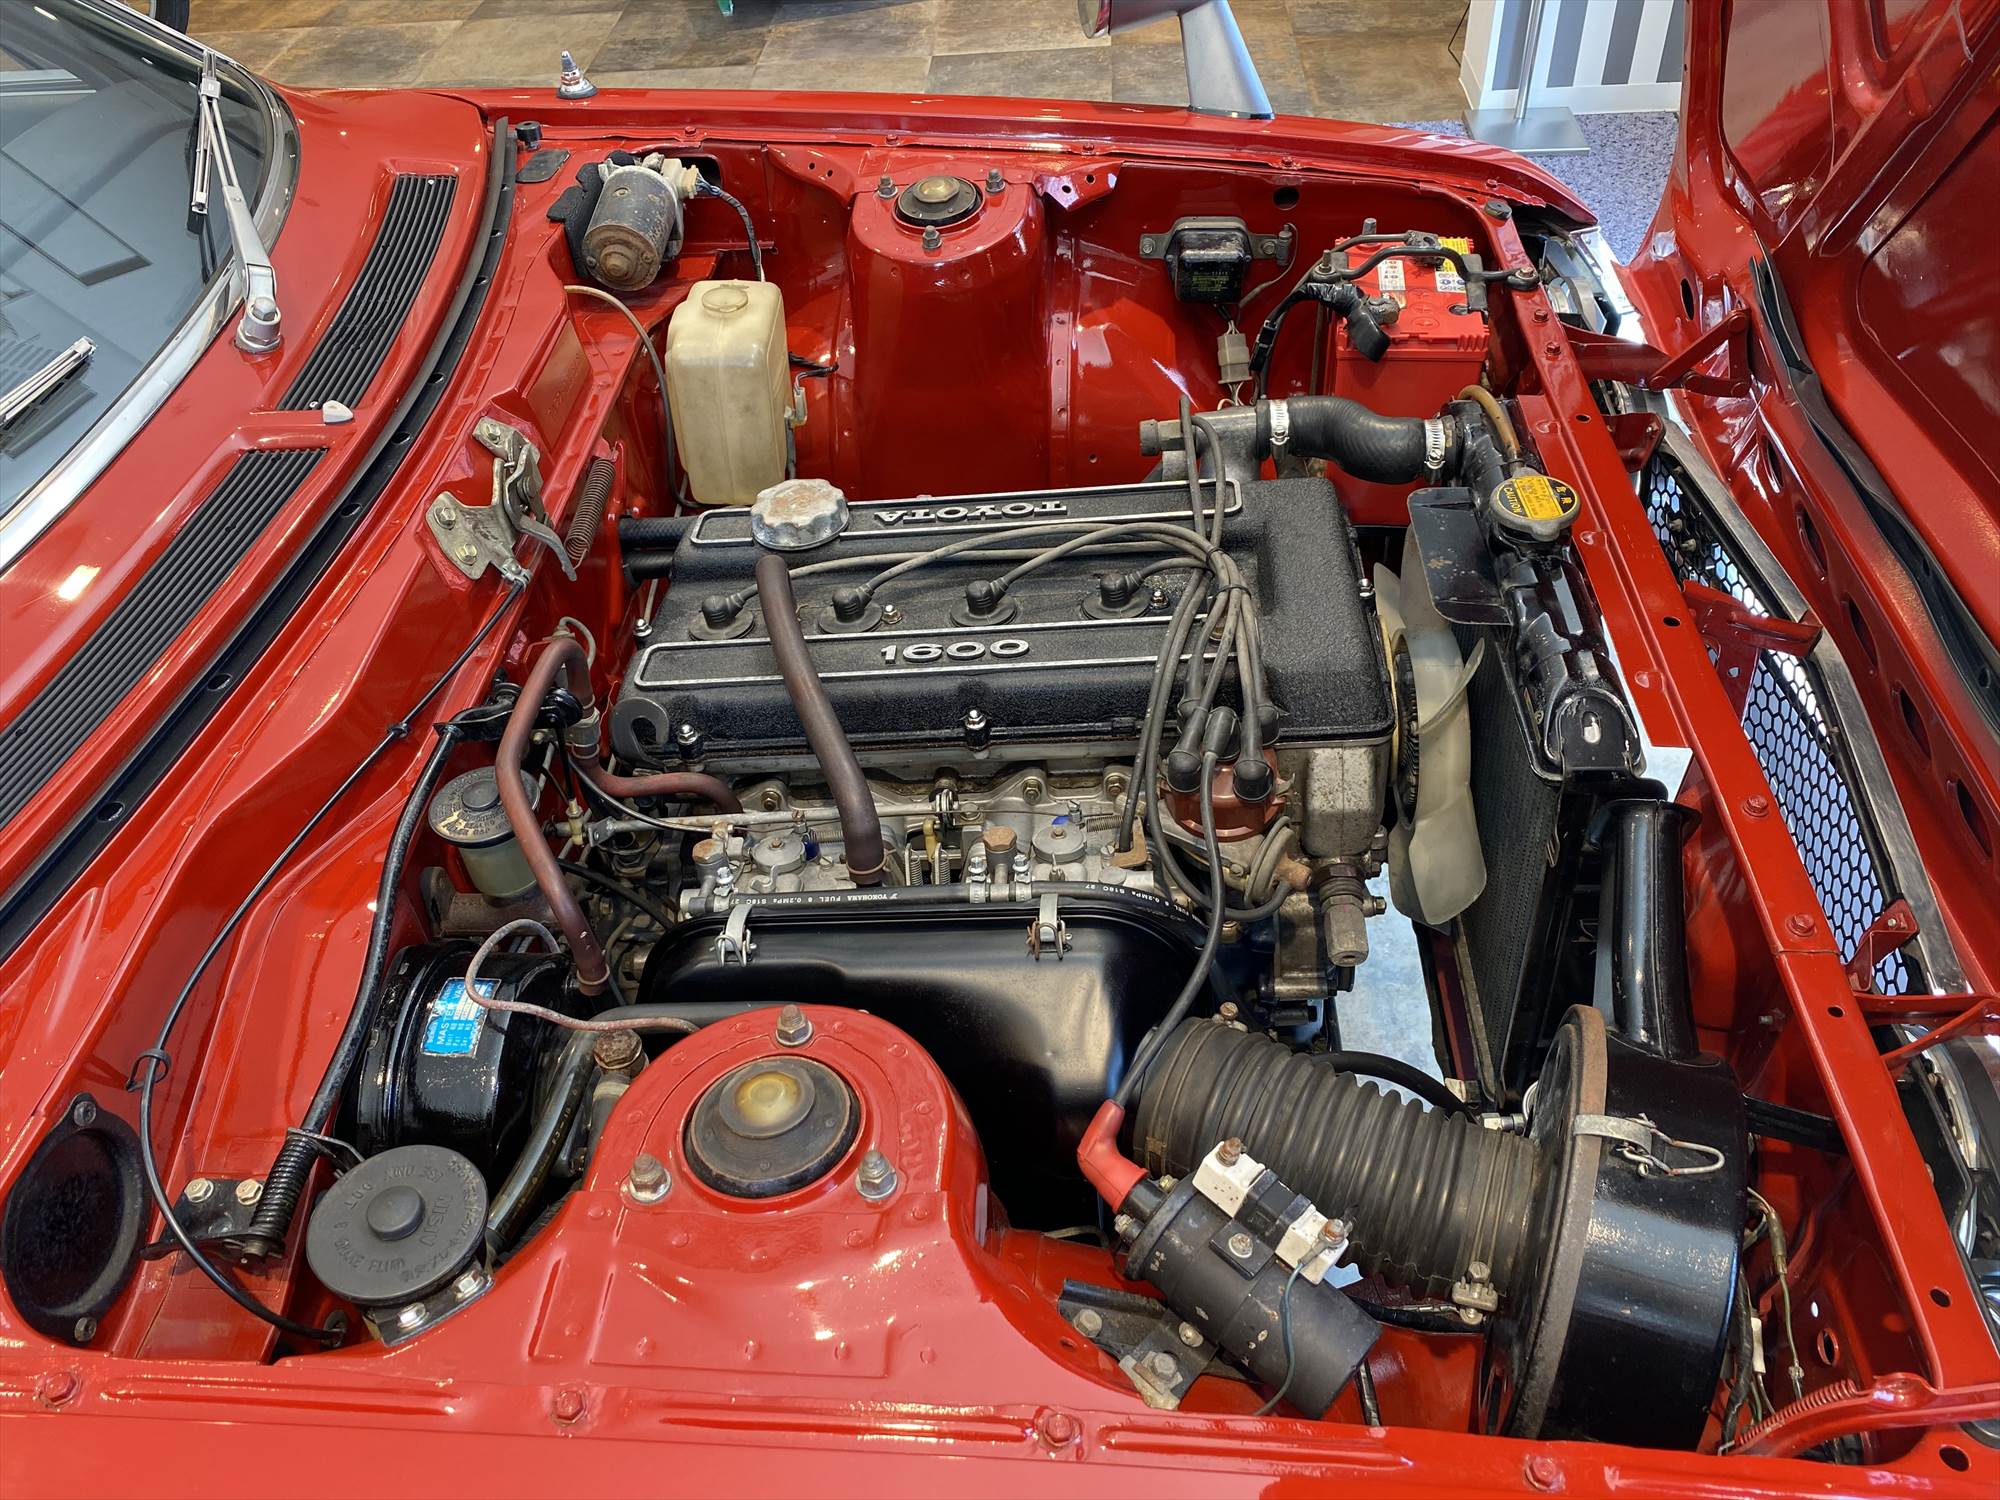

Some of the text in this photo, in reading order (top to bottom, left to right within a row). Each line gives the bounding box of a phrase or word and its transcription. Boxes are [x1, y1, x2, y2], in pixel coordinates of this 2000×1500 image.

[1503, 487, 1522, 513] CAUTION
[874, 500, 1067, 525] TOYOTA
[881, 639, 1030, 664] 1600
[819, 895, 841, 903] FUEL
[847, 893, 888, 901] YOKOHAMA
[1174, 904, 1189, 916] FUEL
